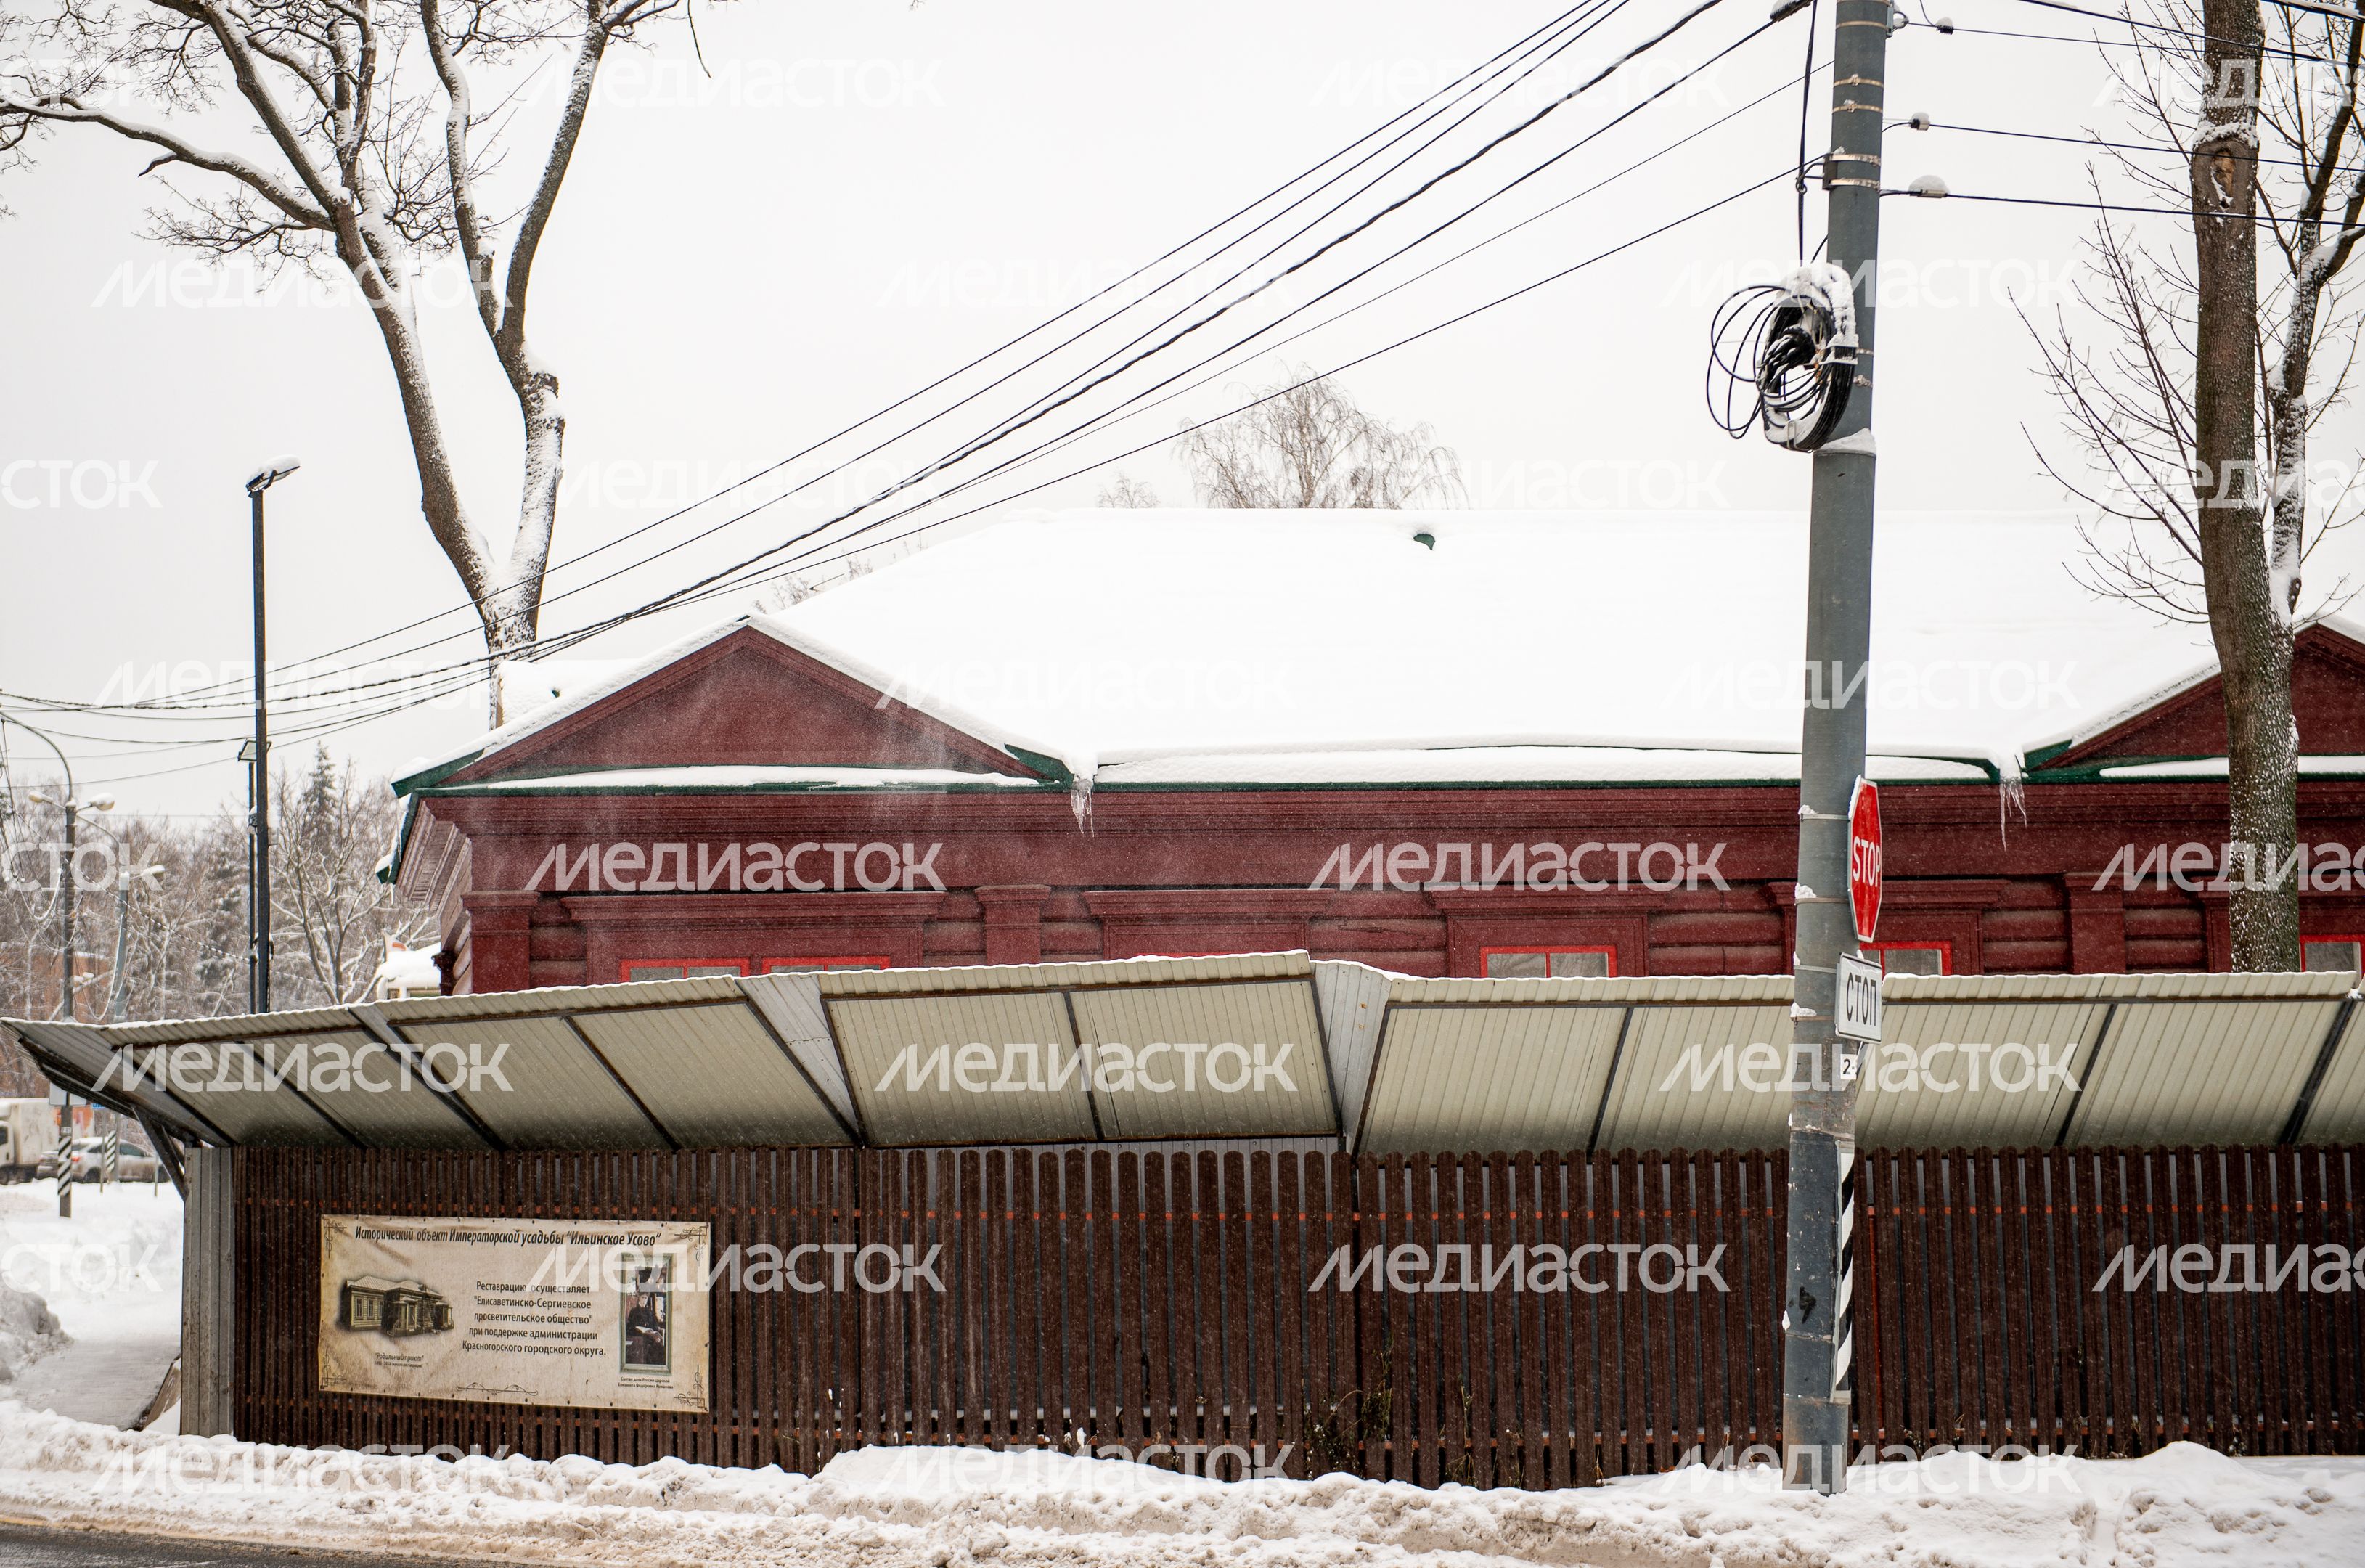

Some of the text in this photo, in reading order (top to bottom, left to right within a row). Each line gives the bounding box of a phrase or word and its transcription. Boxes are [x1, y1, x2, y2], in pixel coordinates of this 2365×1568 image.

[1853, 836, 1882, 887] STOP
[1847, 972, 1877, 1026] СТОП
[356, 1226, 413, 1242] Исторический
[417, 1228, 447, 1241] объект
[449, 1228, 520, 1246] Императорской
[521, 1230, 564, 1246] усадьбы
[476, 1281, 589, 1295] Реставрацию осуществляет
[474, 1295, 592, 1310] "Елисаветинско-Сергиевское
[474, 1311, 593, 1325] просветительское общество"
[469, 1328, 597, 1341] при поддержке администрации
[462, 1340, 606, 1357] Красногорского городского округа.
